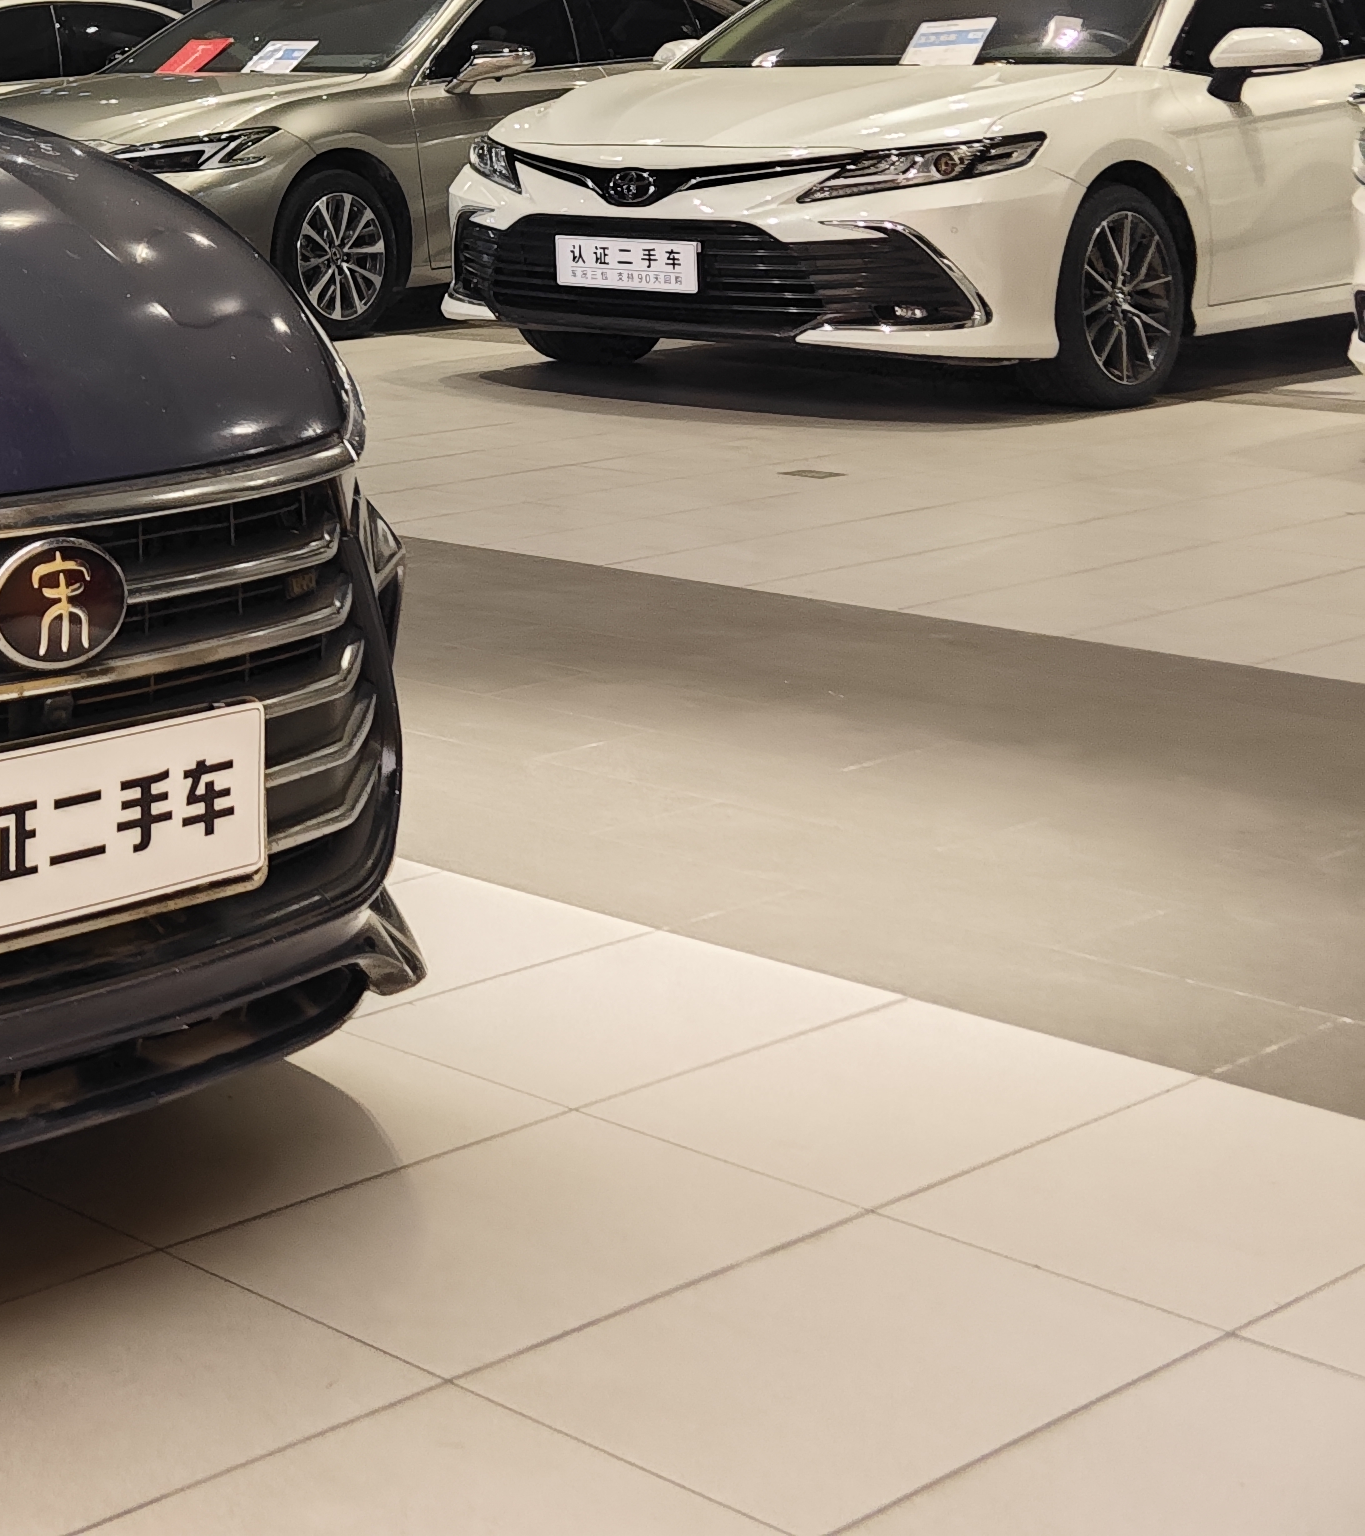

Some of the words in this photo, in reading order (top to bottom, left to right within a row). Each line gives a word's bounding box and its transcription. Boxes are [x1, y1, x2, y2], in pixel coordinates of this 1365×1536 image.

[569, 244, 682, 270] 认证二手车
[570, 269, 609, 281] 车况三包
[616, 272, 684, 286] 支持90天回购
